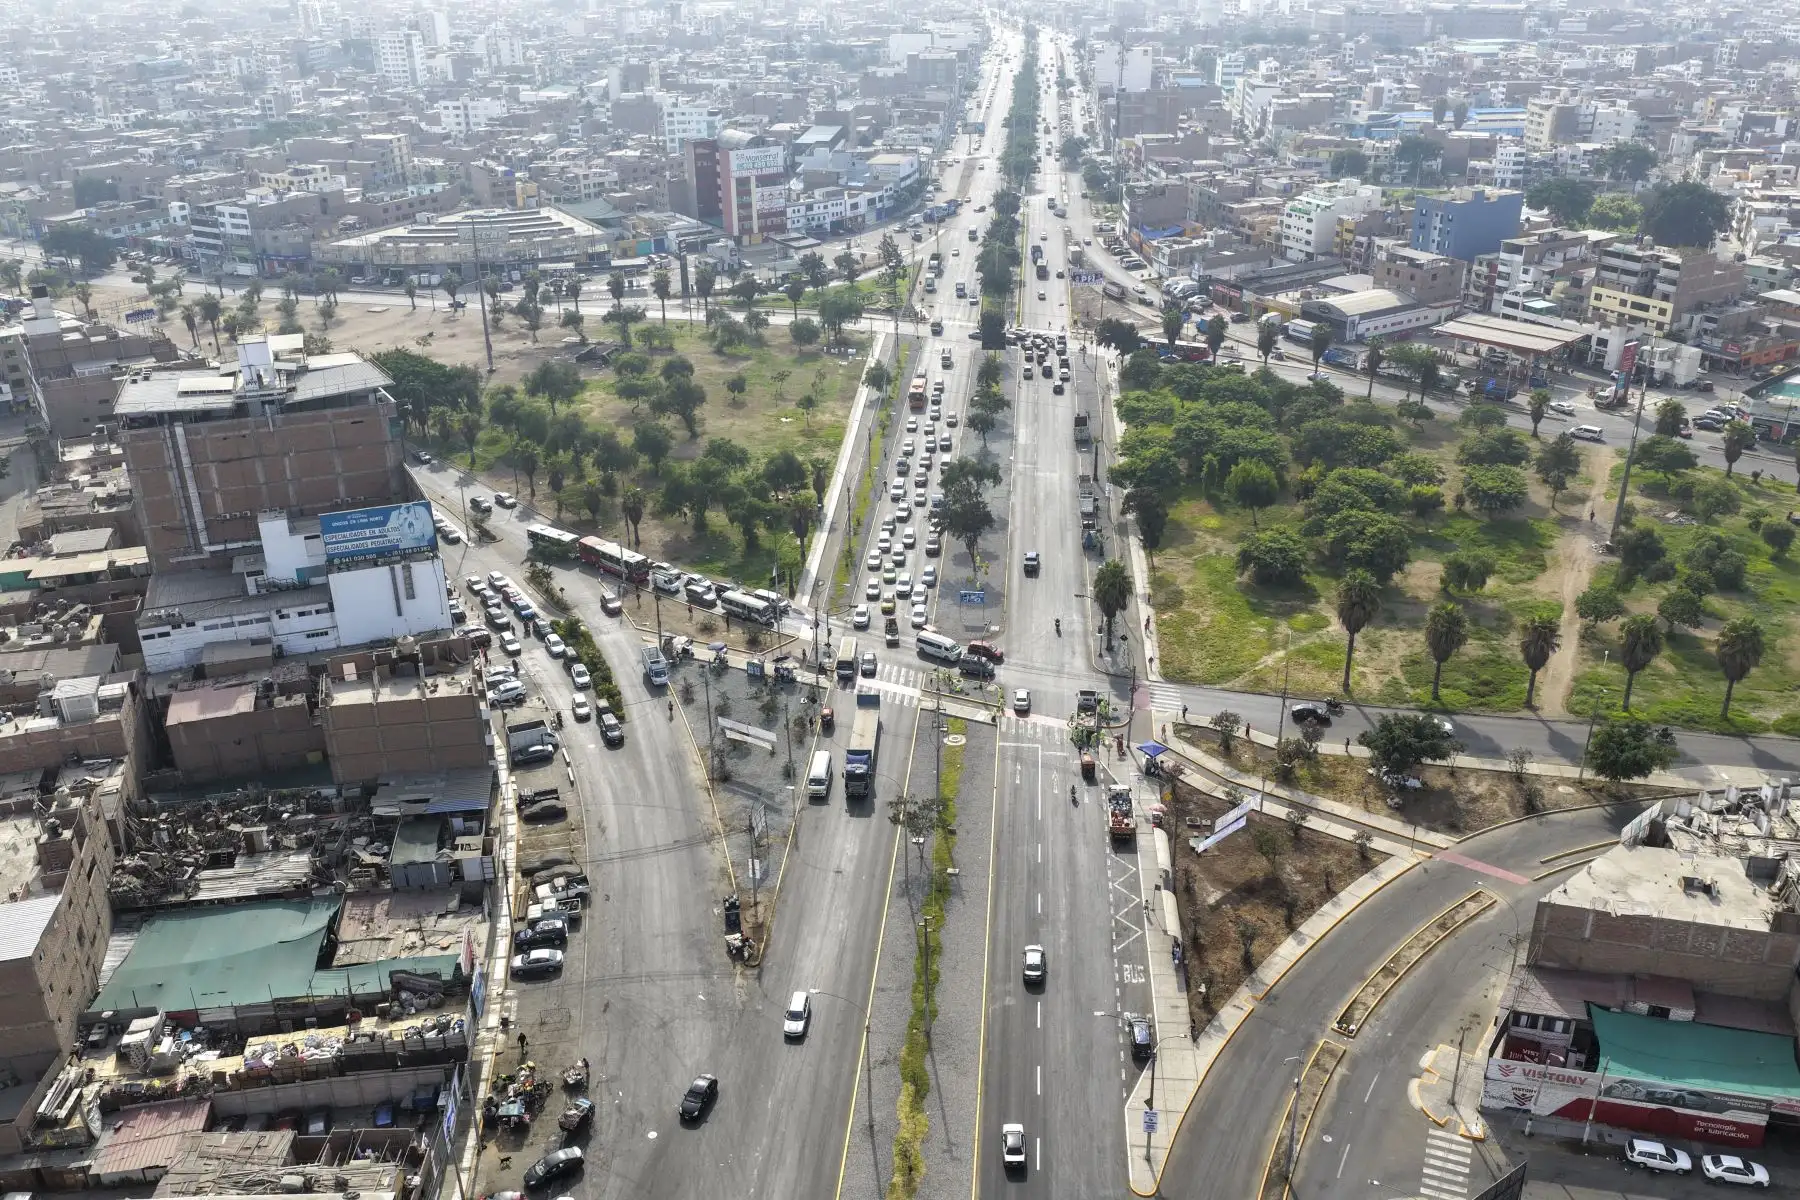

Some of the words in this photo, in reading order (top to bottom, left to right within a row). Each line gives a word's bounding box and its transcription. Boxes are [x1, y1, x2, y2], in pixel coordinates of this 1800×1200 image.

[325, 530, 367, 542] ESPECIALIDADES
[378, 526, 401, 535] ADULTOS
[326, 541, 369, 553] ESPECIALIDADES
[1123, 964, 1145, 983] BUS
[1521, 1068, 1588, 1085] VISTONY
[1511, 1086, 1537, 1094] VISTONY
[1696, 1120, 1737, 1131] Tecnología
[1708, 1128, 1749, 1140] lubricación
